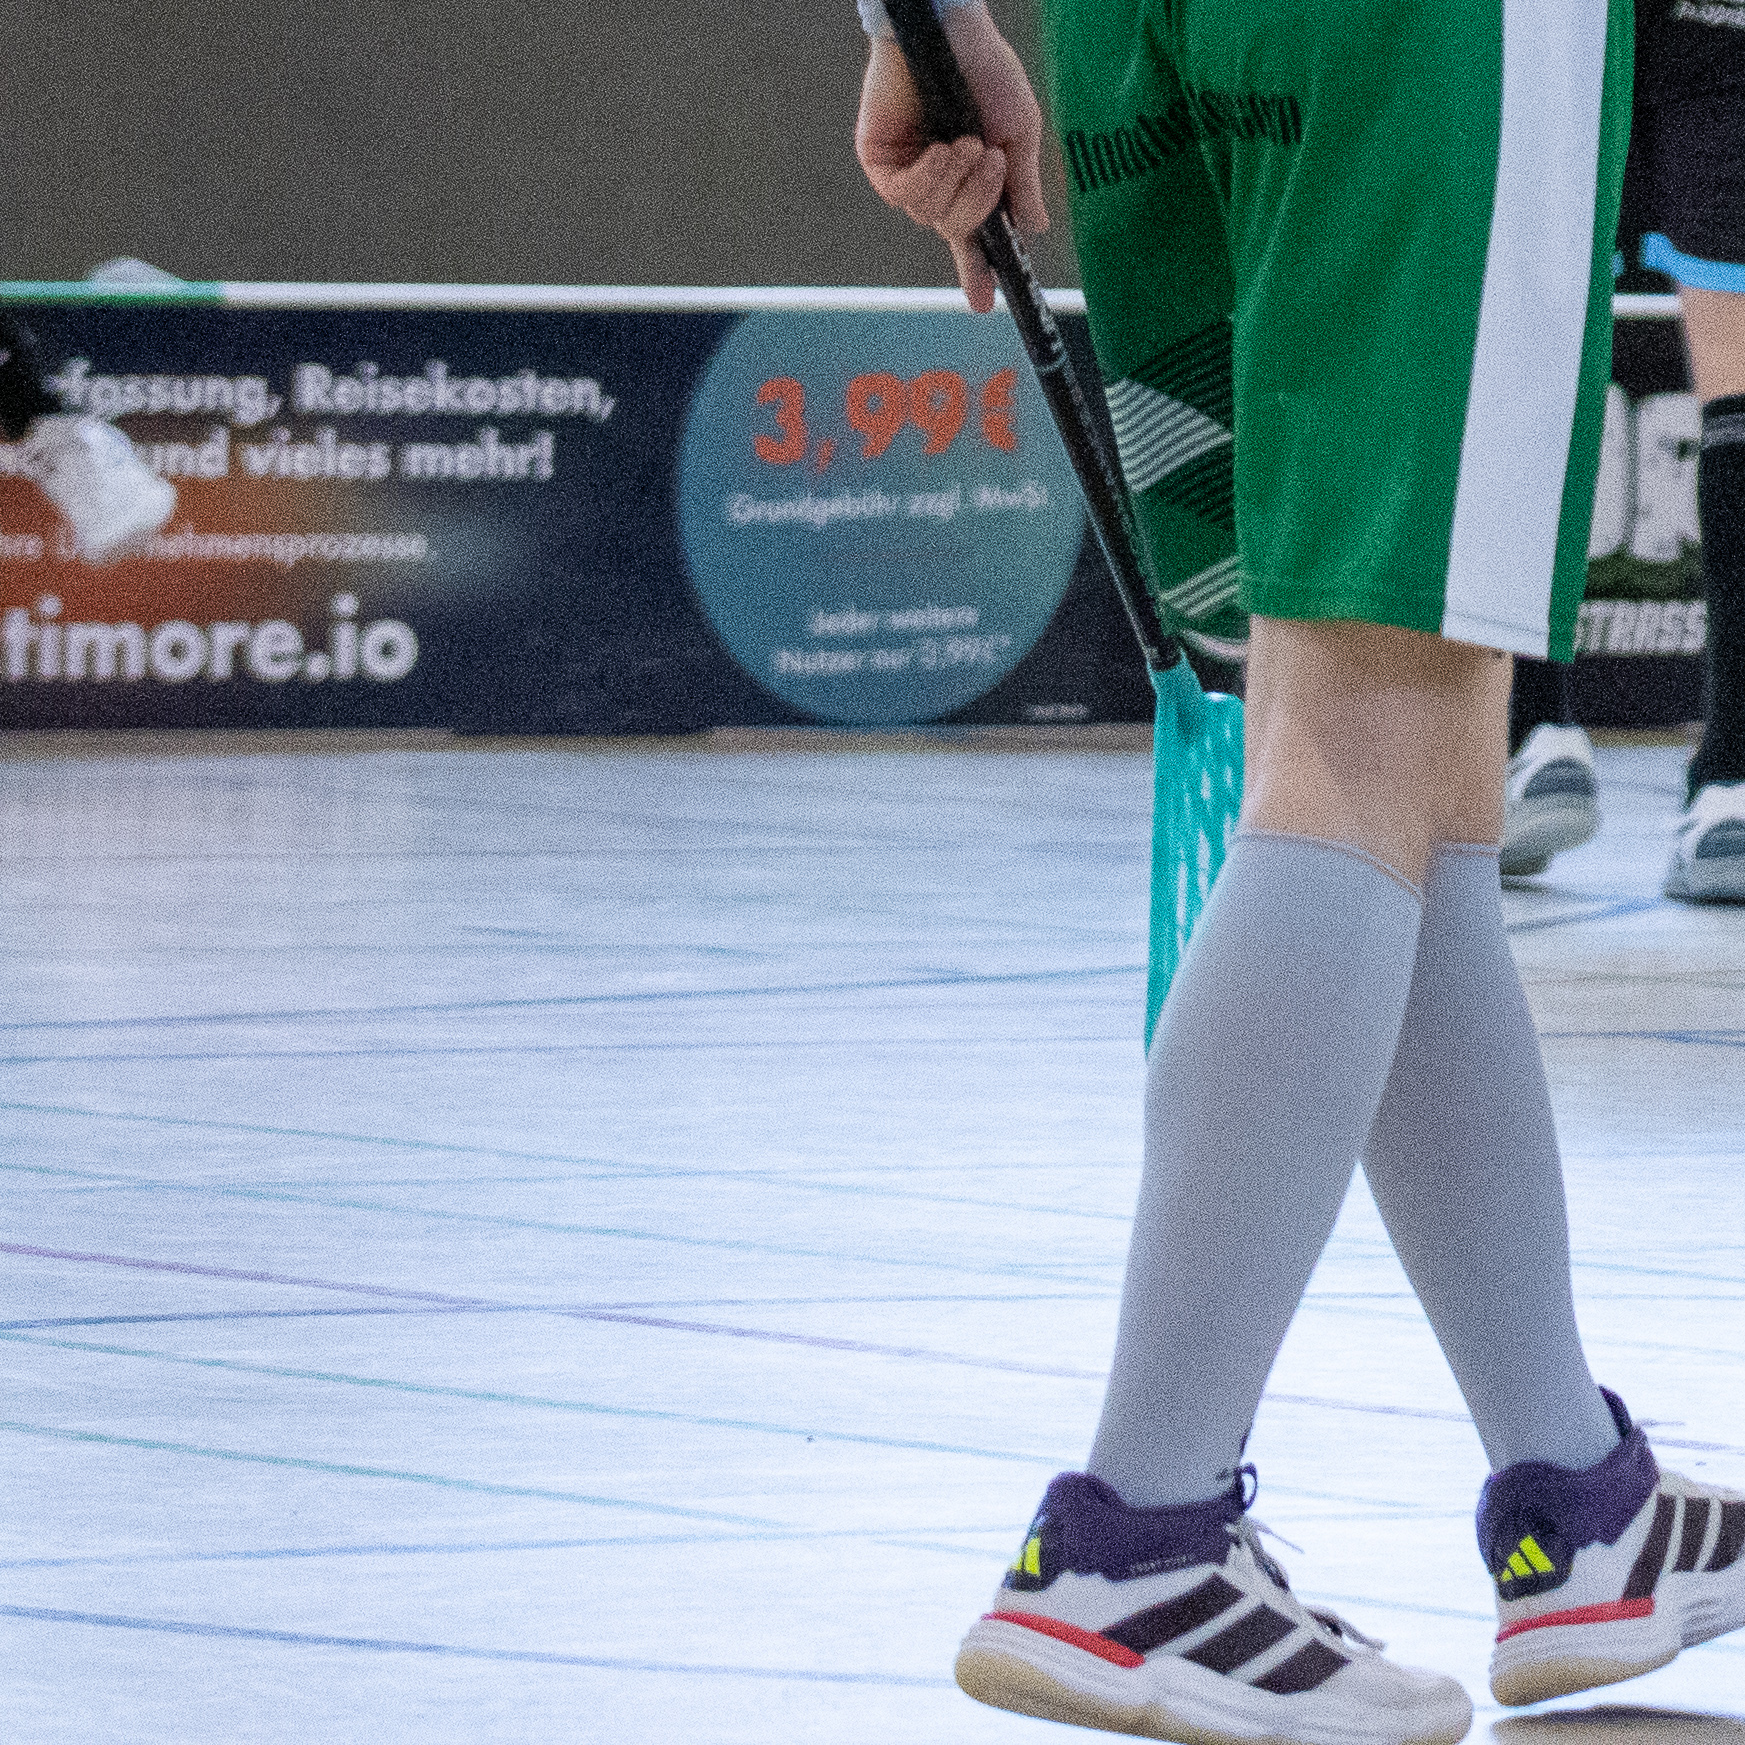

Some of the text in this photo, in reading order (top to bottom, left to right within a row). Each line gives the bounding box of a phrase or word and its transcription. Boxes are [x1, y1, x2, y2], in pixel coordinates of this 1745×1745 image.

[294, 360, 617, 423] Reisekosten,
[241, 426, 393, 480] vieles
[401, 426, 556, 481] mehr!
